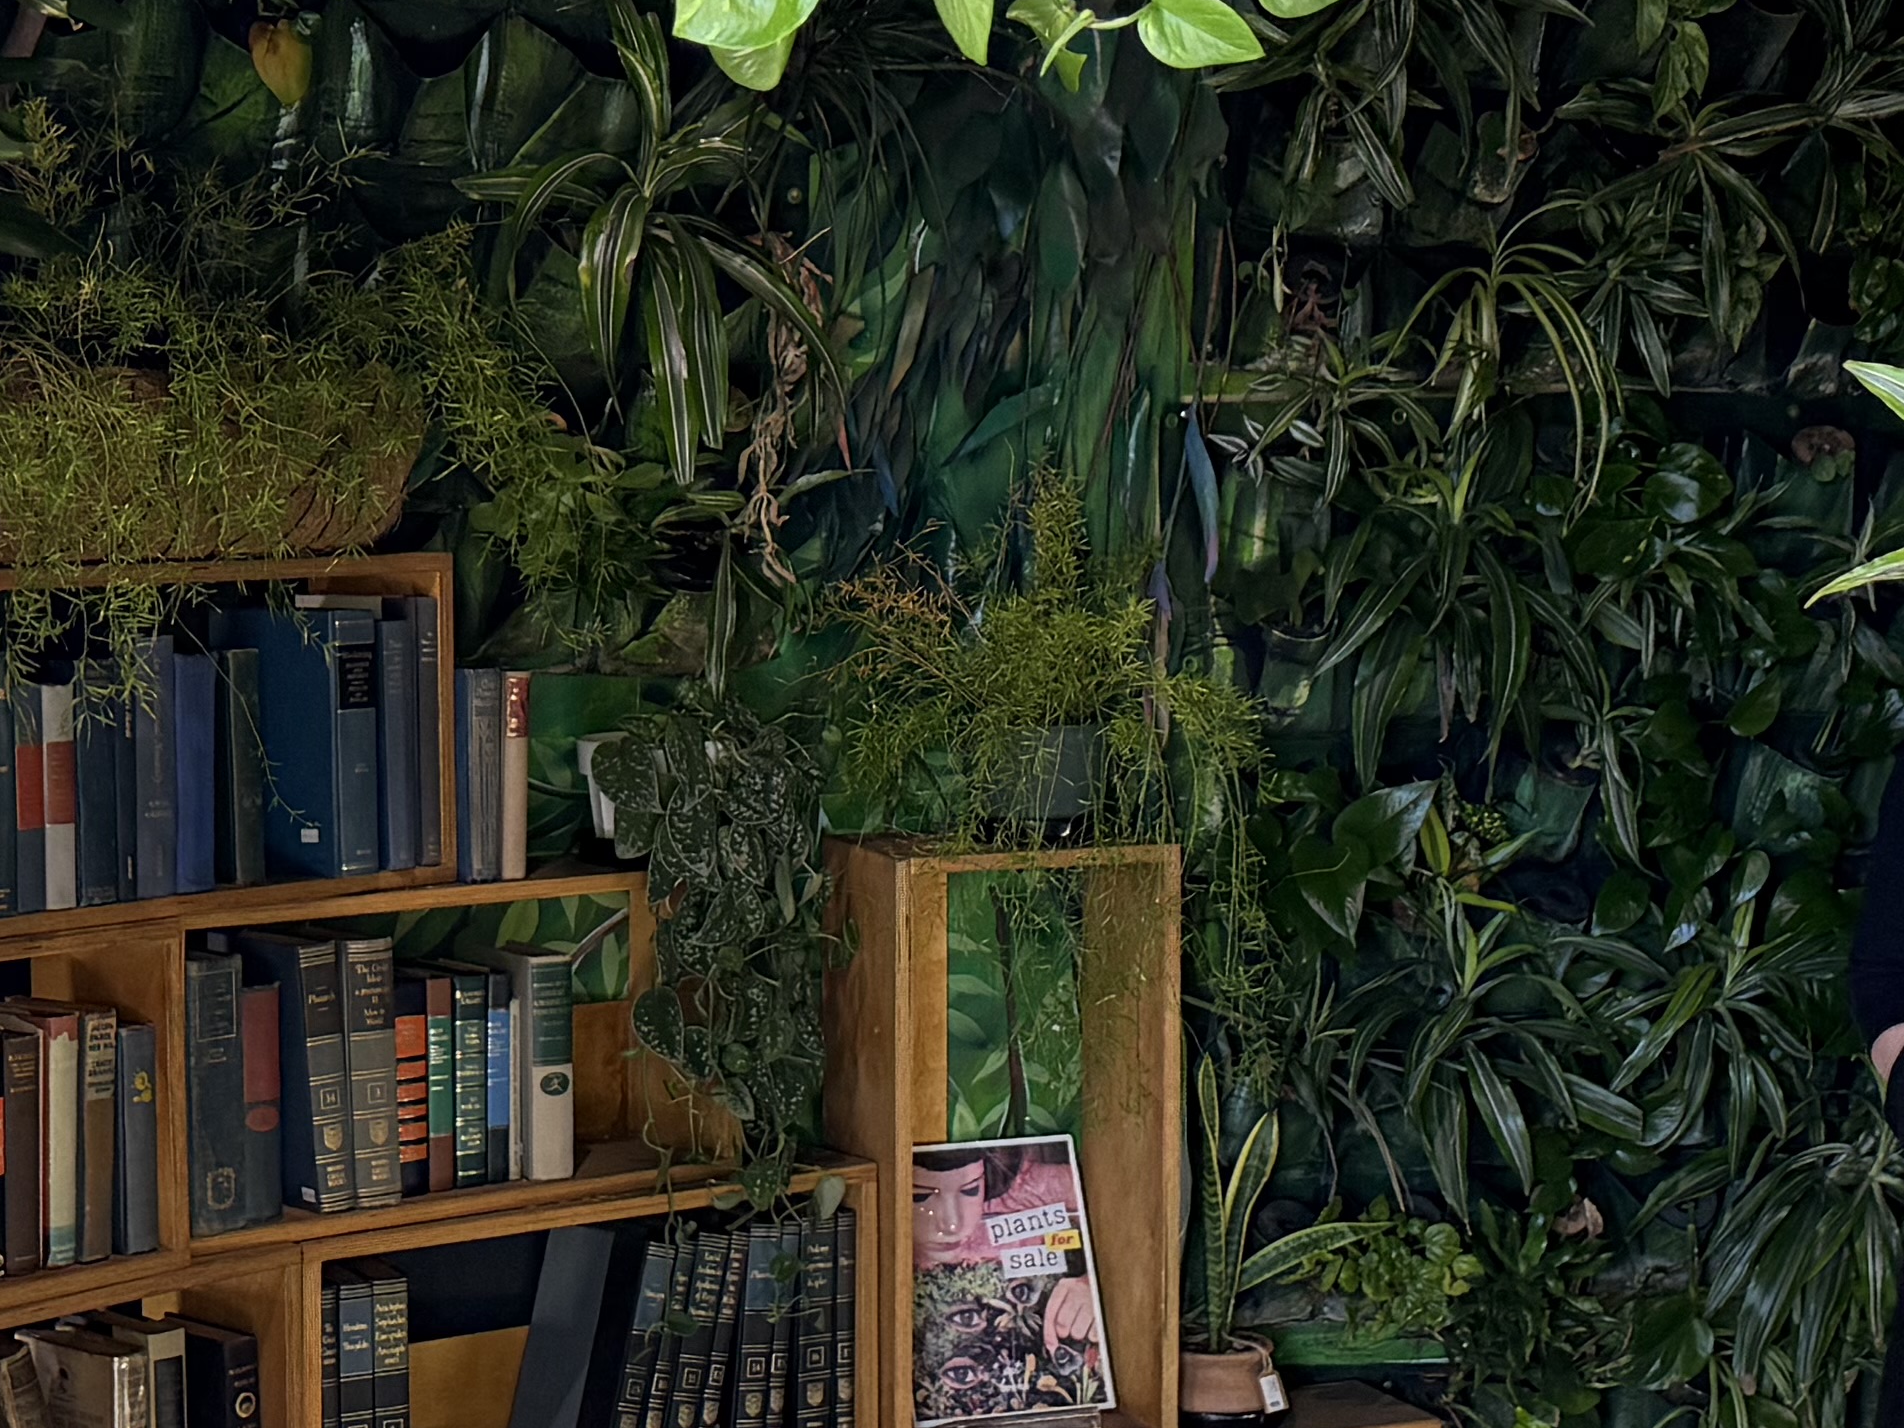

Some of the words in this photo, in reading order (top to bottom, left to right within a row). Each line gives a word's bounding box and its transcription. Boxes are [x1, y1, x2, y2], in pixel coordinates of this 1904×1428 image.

[989, 1204, 1069, 1245] plants
[1048, 1232, 1075, 1248] for
[1008, 1247, 1060, 1271] sale
